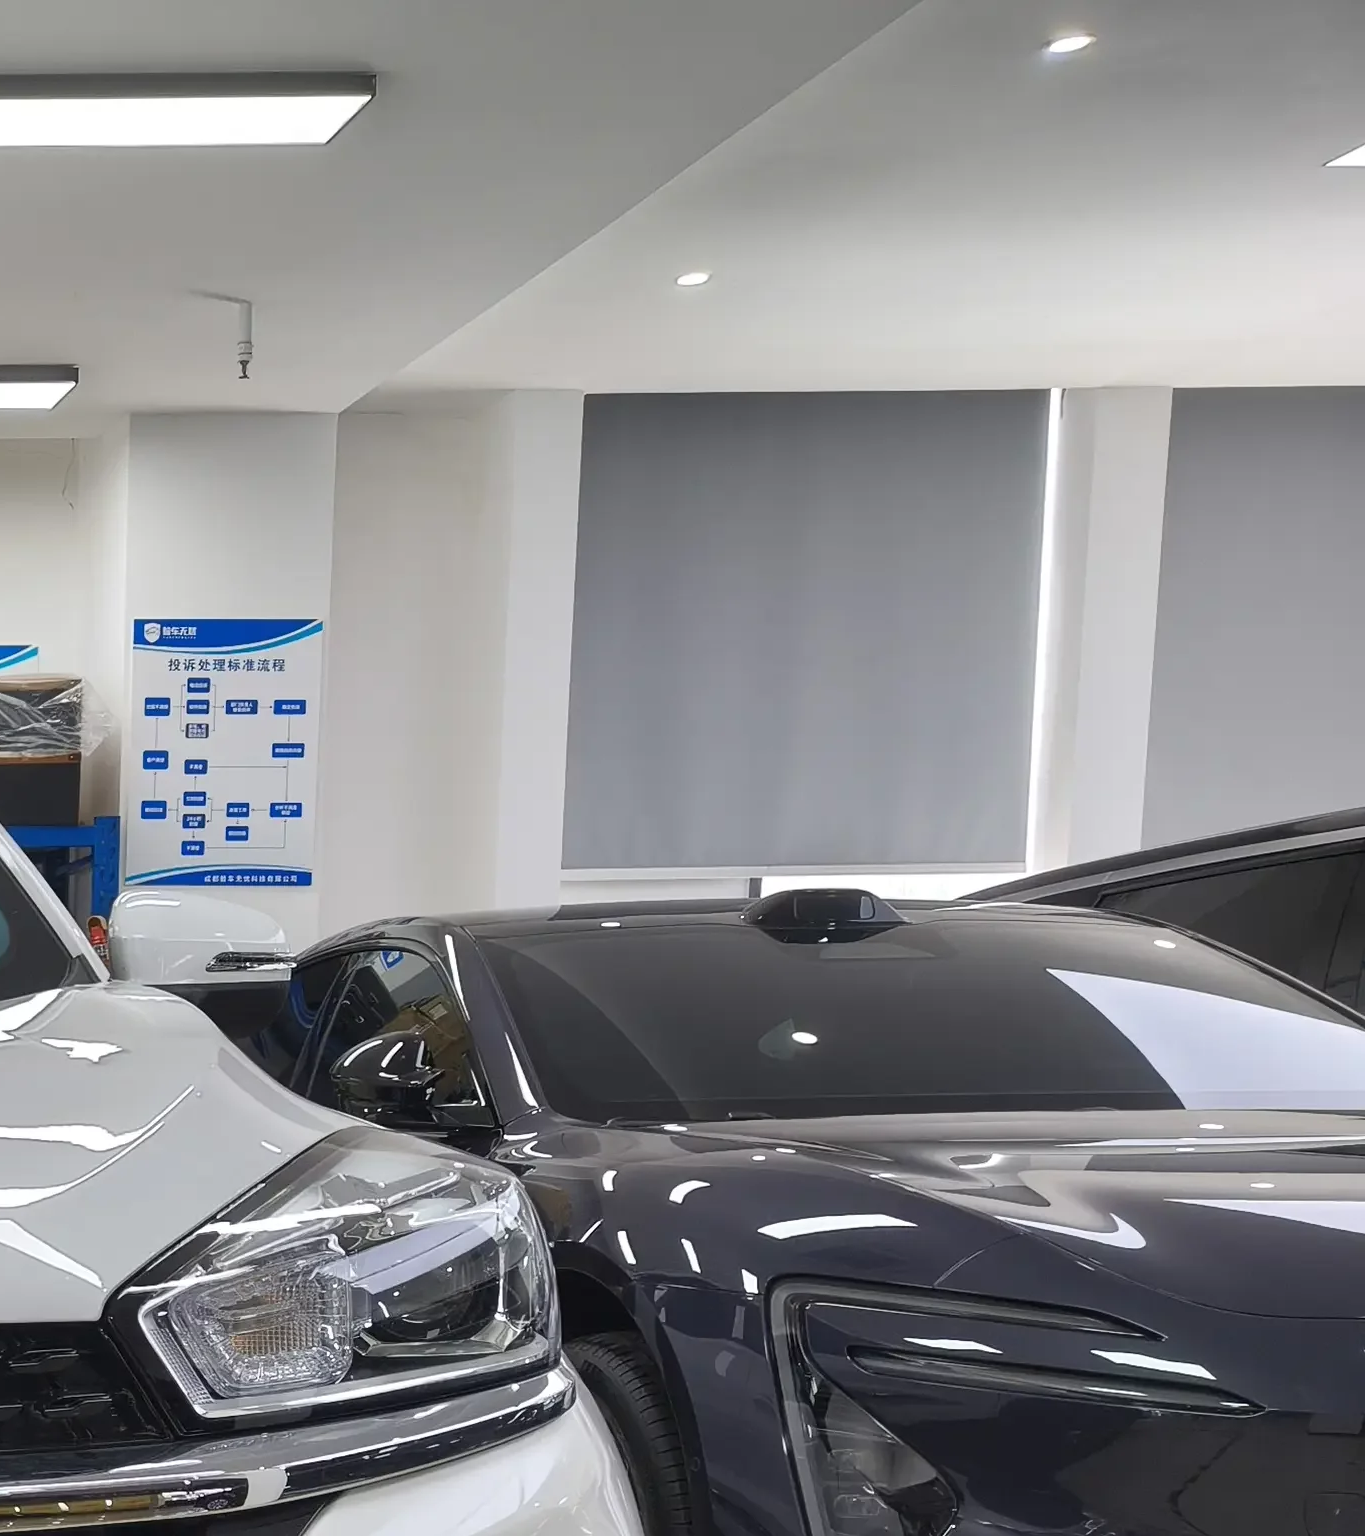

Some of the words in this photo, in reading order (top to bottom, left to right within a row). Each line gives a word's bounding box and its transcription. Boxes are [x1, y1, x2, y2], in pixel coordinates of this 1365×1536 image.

[168, 658, 286, 673] 投诉处理标准流程
